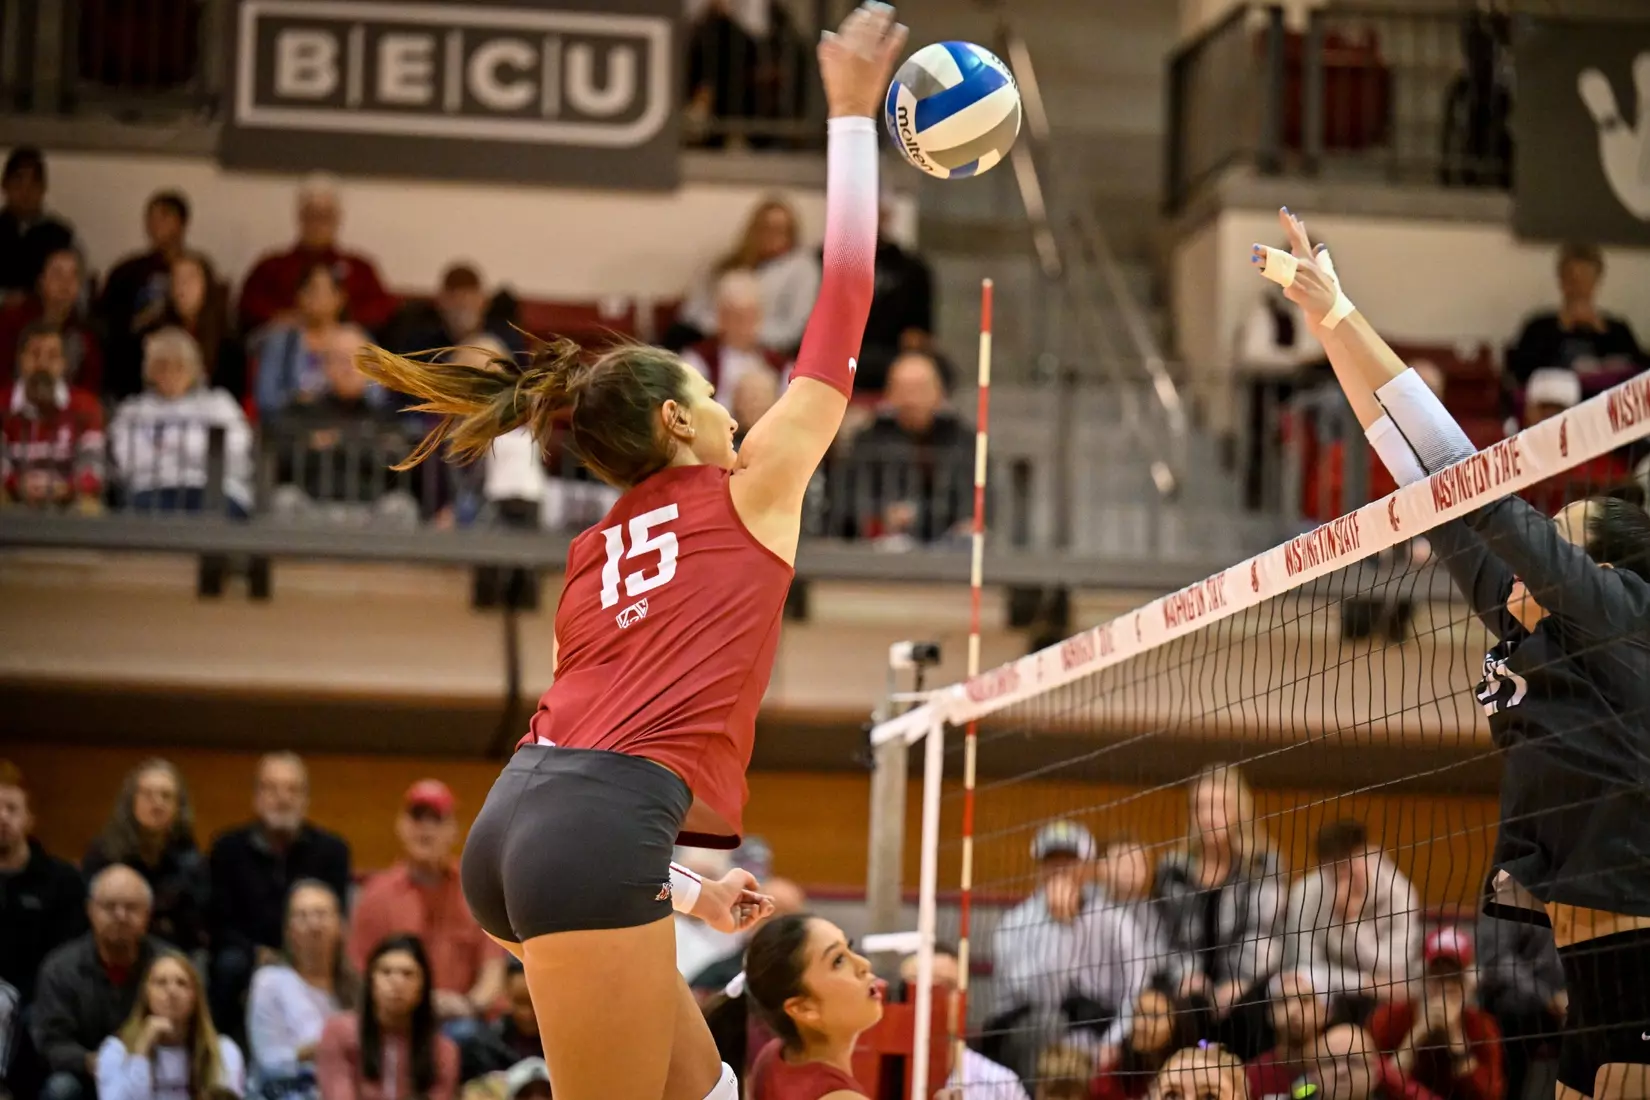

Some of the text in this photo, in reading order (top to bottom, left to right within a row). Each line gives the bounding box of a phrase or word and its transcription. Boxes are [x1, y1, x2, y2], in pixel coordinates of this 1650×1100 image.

[275, 28, 637, 117] BECU
[898, 106, 934, 172] molten
[600, 503, 679, 610] 15
